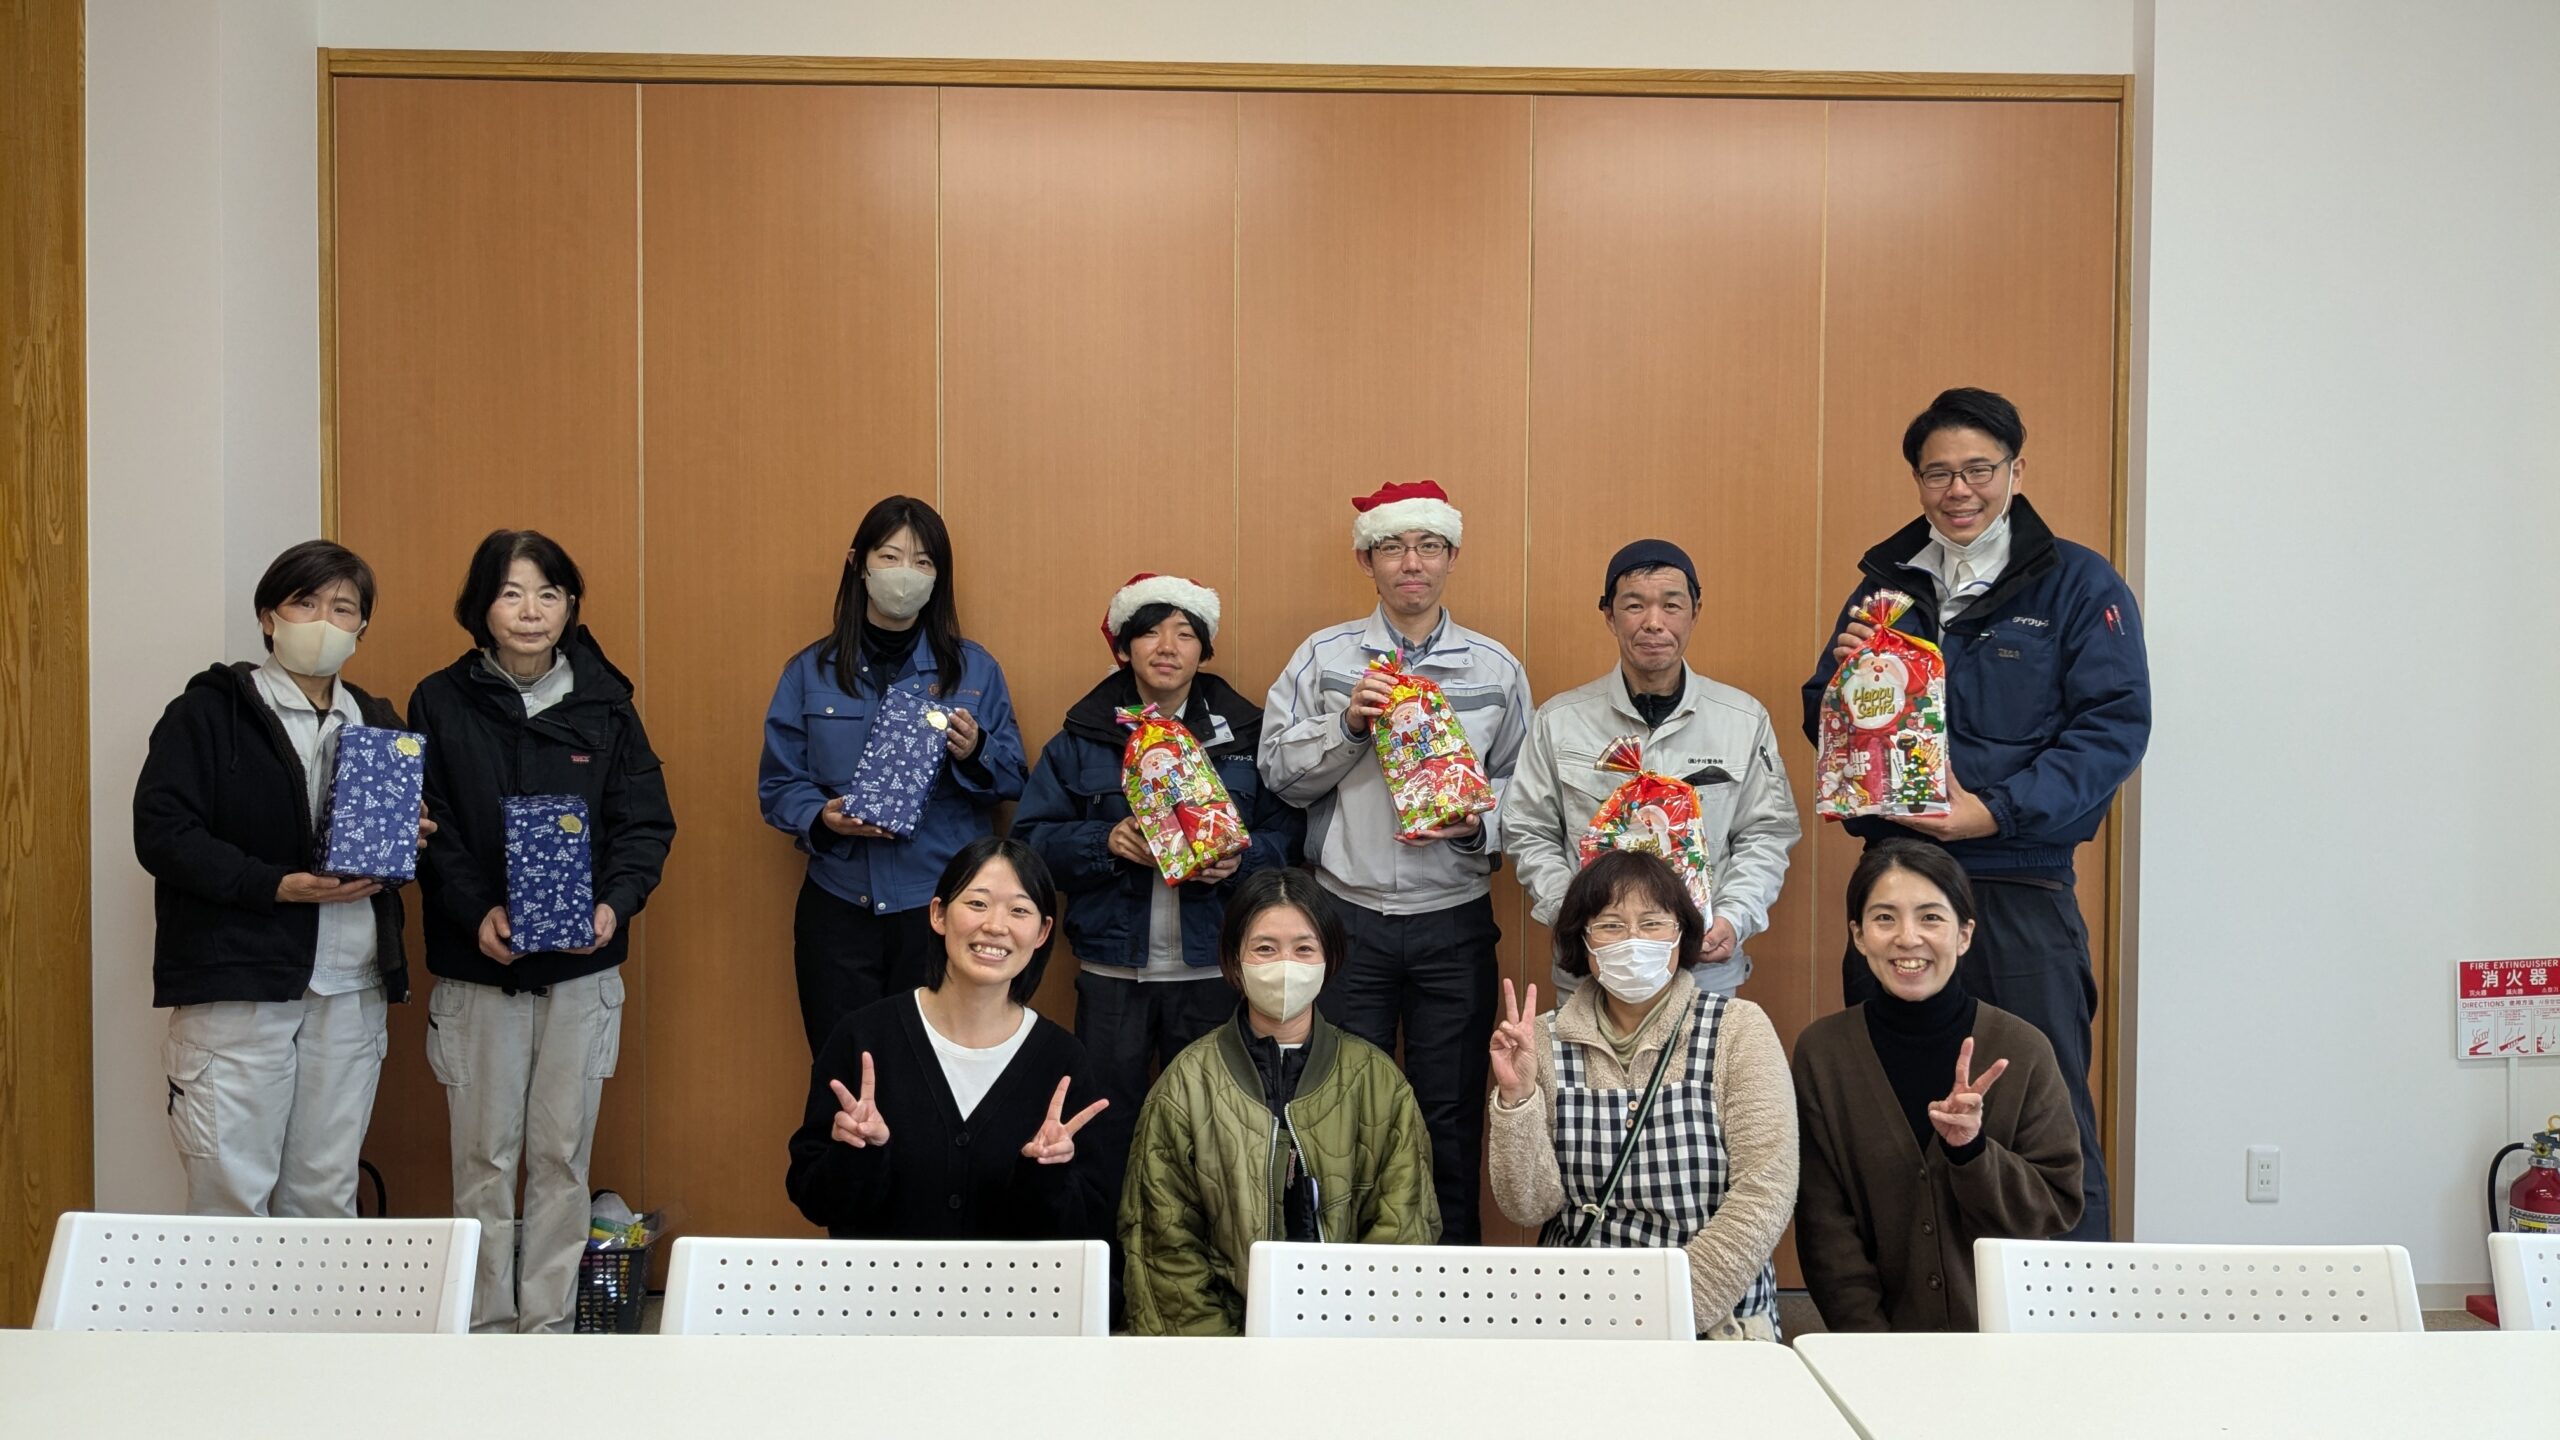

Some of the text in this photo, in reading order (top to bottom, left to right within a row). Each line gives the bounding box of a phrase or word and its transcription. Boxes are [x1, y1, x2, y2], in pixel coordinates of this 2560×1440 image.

[1853, 686, 1895, 706] Happy
[1856, 702, 1896, 719] Santa
[1390, 719, 1437, 749] HAPPY
[2469, 959, 2559, 971] FIRE EXTINGUISHER
[2481, 968, 2548, 988] 消火器
[2461, 1000, 2505, 1008] DIRECTIONS
